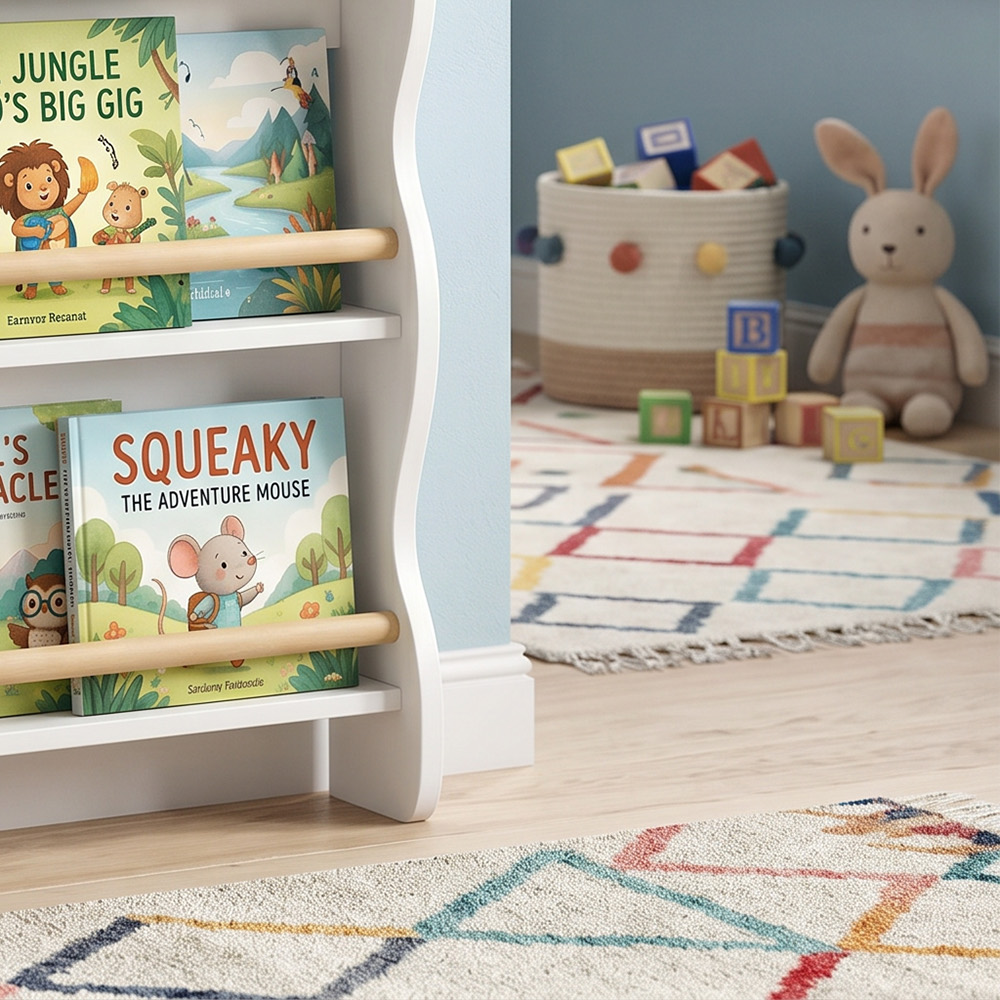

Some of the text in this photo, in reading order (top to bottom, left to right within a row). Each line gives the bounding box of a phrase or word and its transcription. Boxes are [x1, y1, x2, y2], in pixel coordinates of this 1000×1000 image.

[12, 49, 120, 83] JUNGLE
[41, 89, 87, 121] BIG
[96, 87, 143, 119] GIG
[741, 316, 766, 344] B
[113, 420, 317, 485] SQUEAKY
[122, 479, 310, 513] THE ADVENTURE MOUSE
